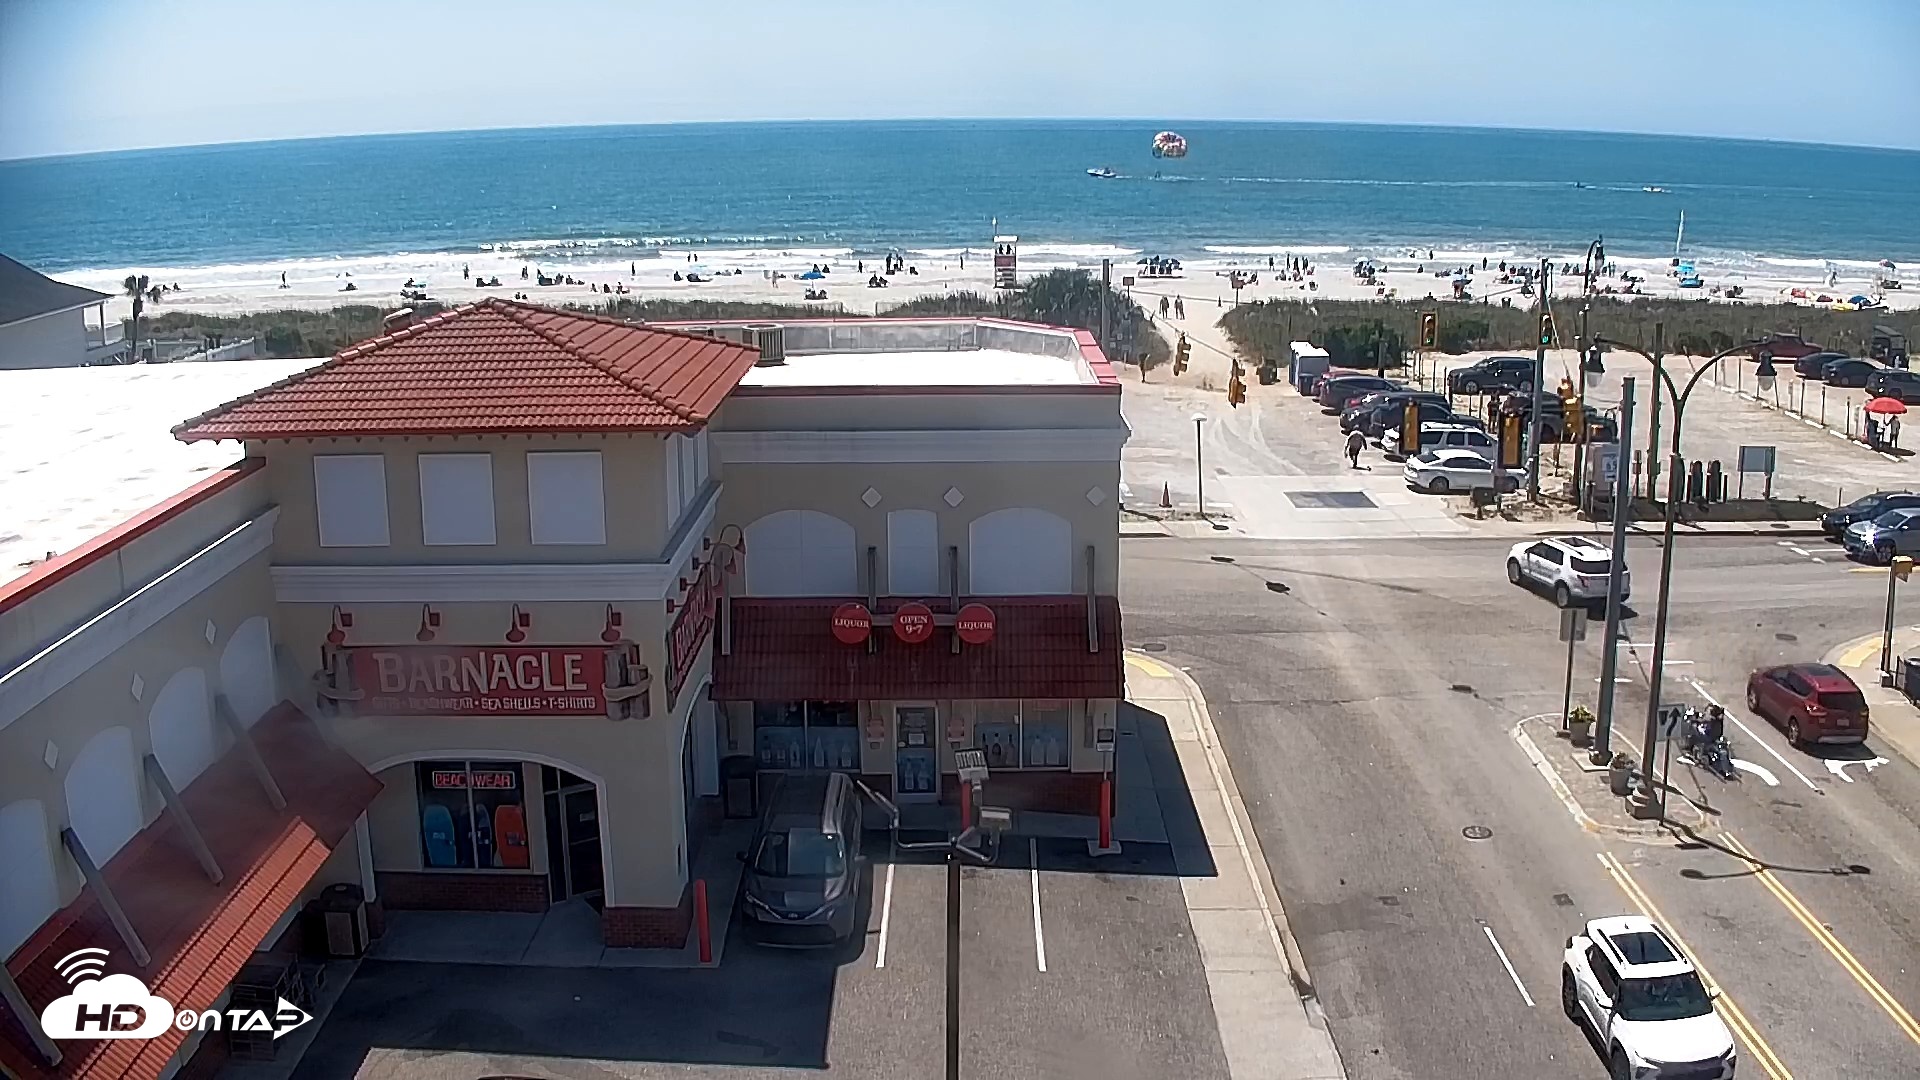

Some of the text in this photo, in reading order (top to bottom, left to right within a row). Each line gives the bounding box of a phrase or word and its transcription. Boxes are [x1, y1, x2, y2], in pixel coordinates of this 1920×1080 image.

[834, 618, 869, 629] LIQUOR
[900, 615, 928, 624] OPEN
[905, 625, 924, 634] 9-7
[958, 621, 993, 630] LIQUOR
[372, 652, 588, 694] BARNACLE
[547, 697, 596, 710] T-SHIRTS
